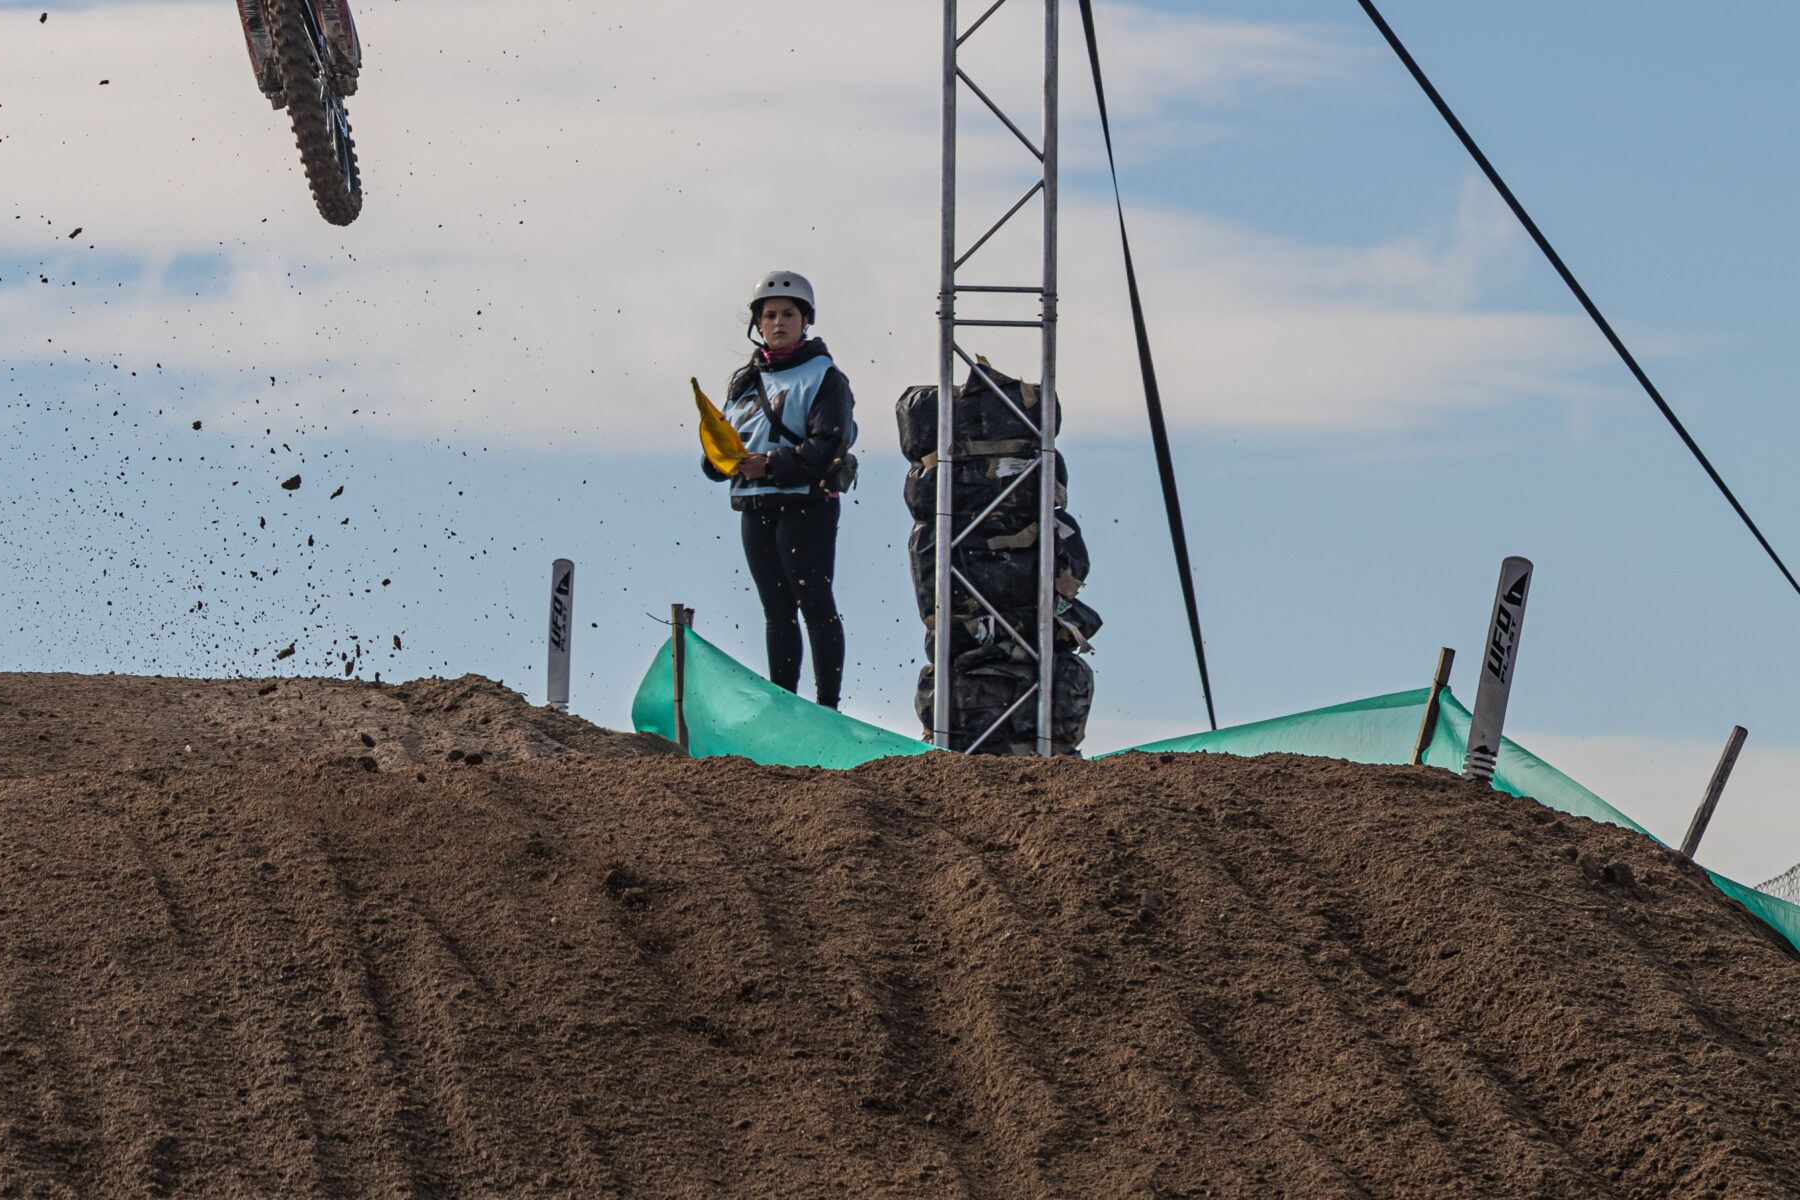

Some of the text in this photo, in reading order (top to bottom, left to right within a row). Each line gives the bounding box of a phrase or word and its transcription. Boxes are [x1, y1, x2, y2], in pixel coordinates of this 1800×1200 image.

[550, 594, 563, 649] UFO
[1487, 604, 1512, 679] UFO
[1500, 617, 1517, 683] PLAST
